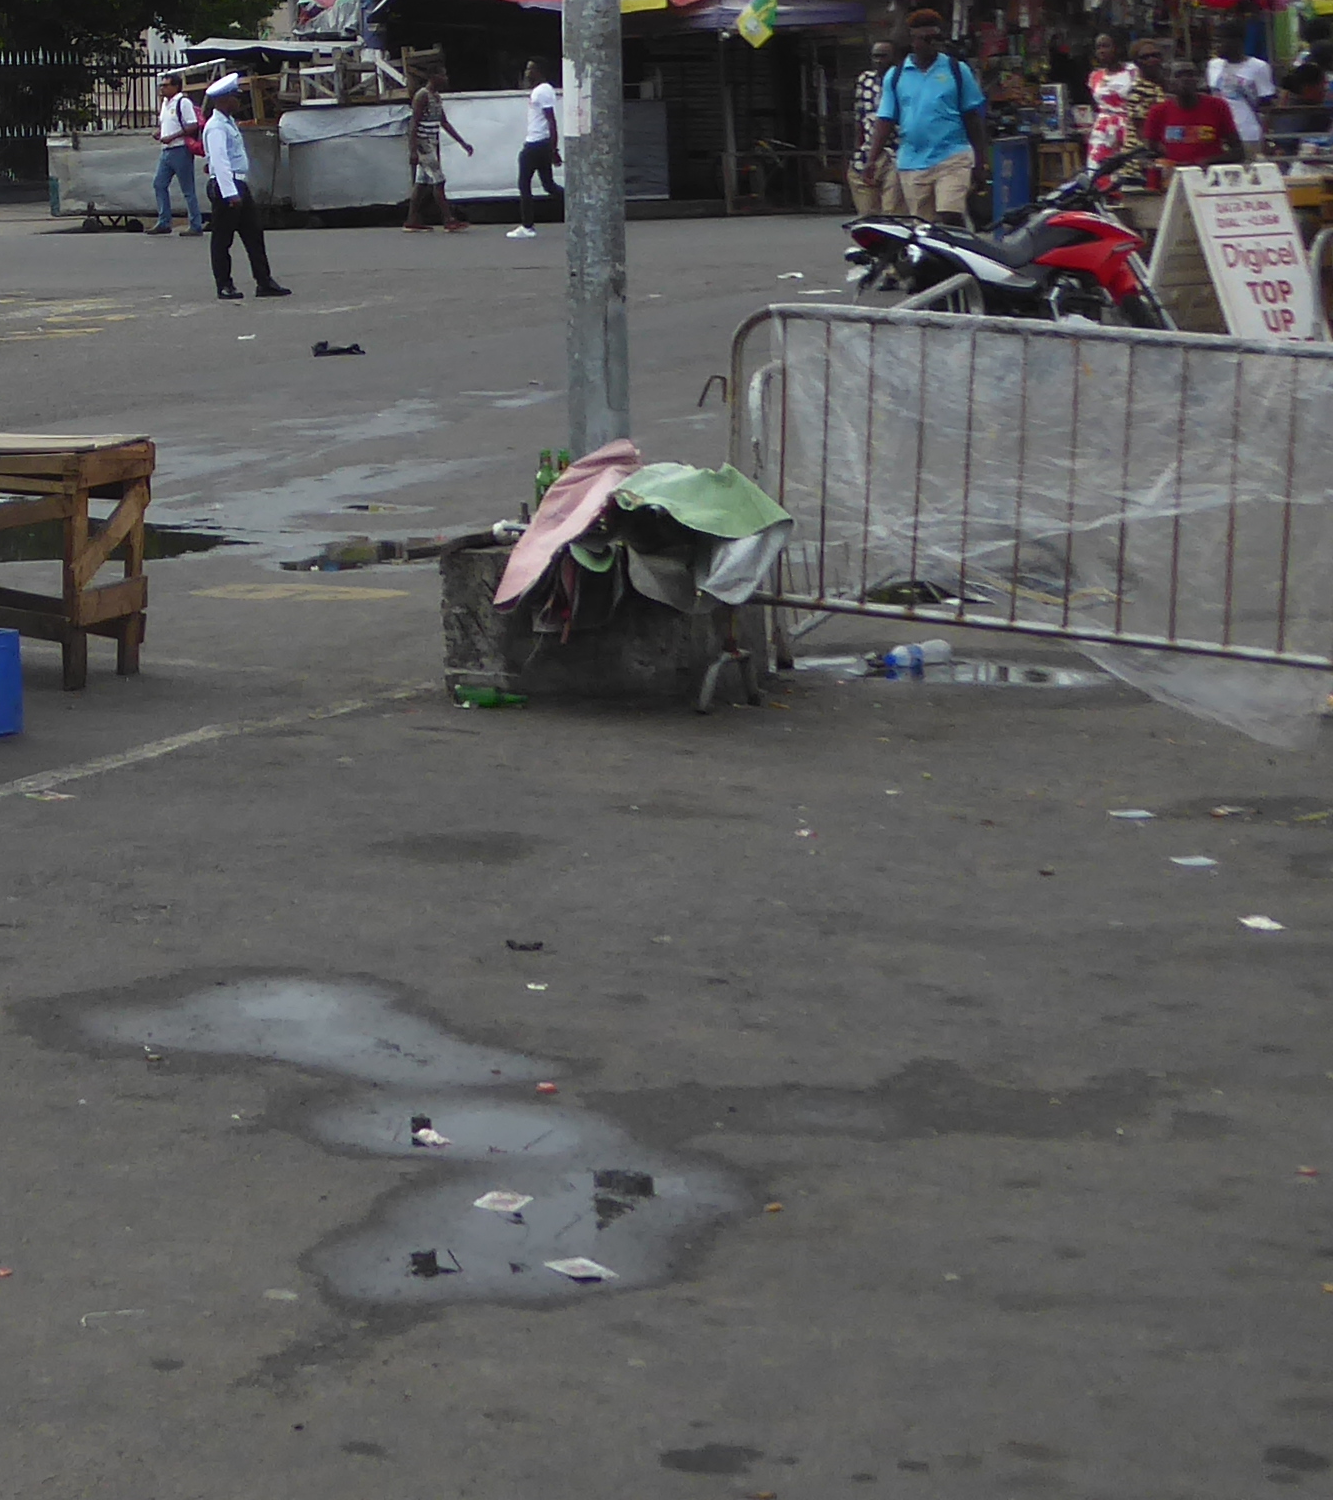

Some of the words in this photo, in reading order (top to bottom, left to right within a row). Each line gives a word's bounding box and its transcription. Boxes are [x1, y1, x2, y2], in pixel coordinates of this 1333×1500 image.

[1221, 240, 1299, 274] Digicel
[1245, 280, 1294, 305] TOP
[1262, 308, 1296, 333] UP
